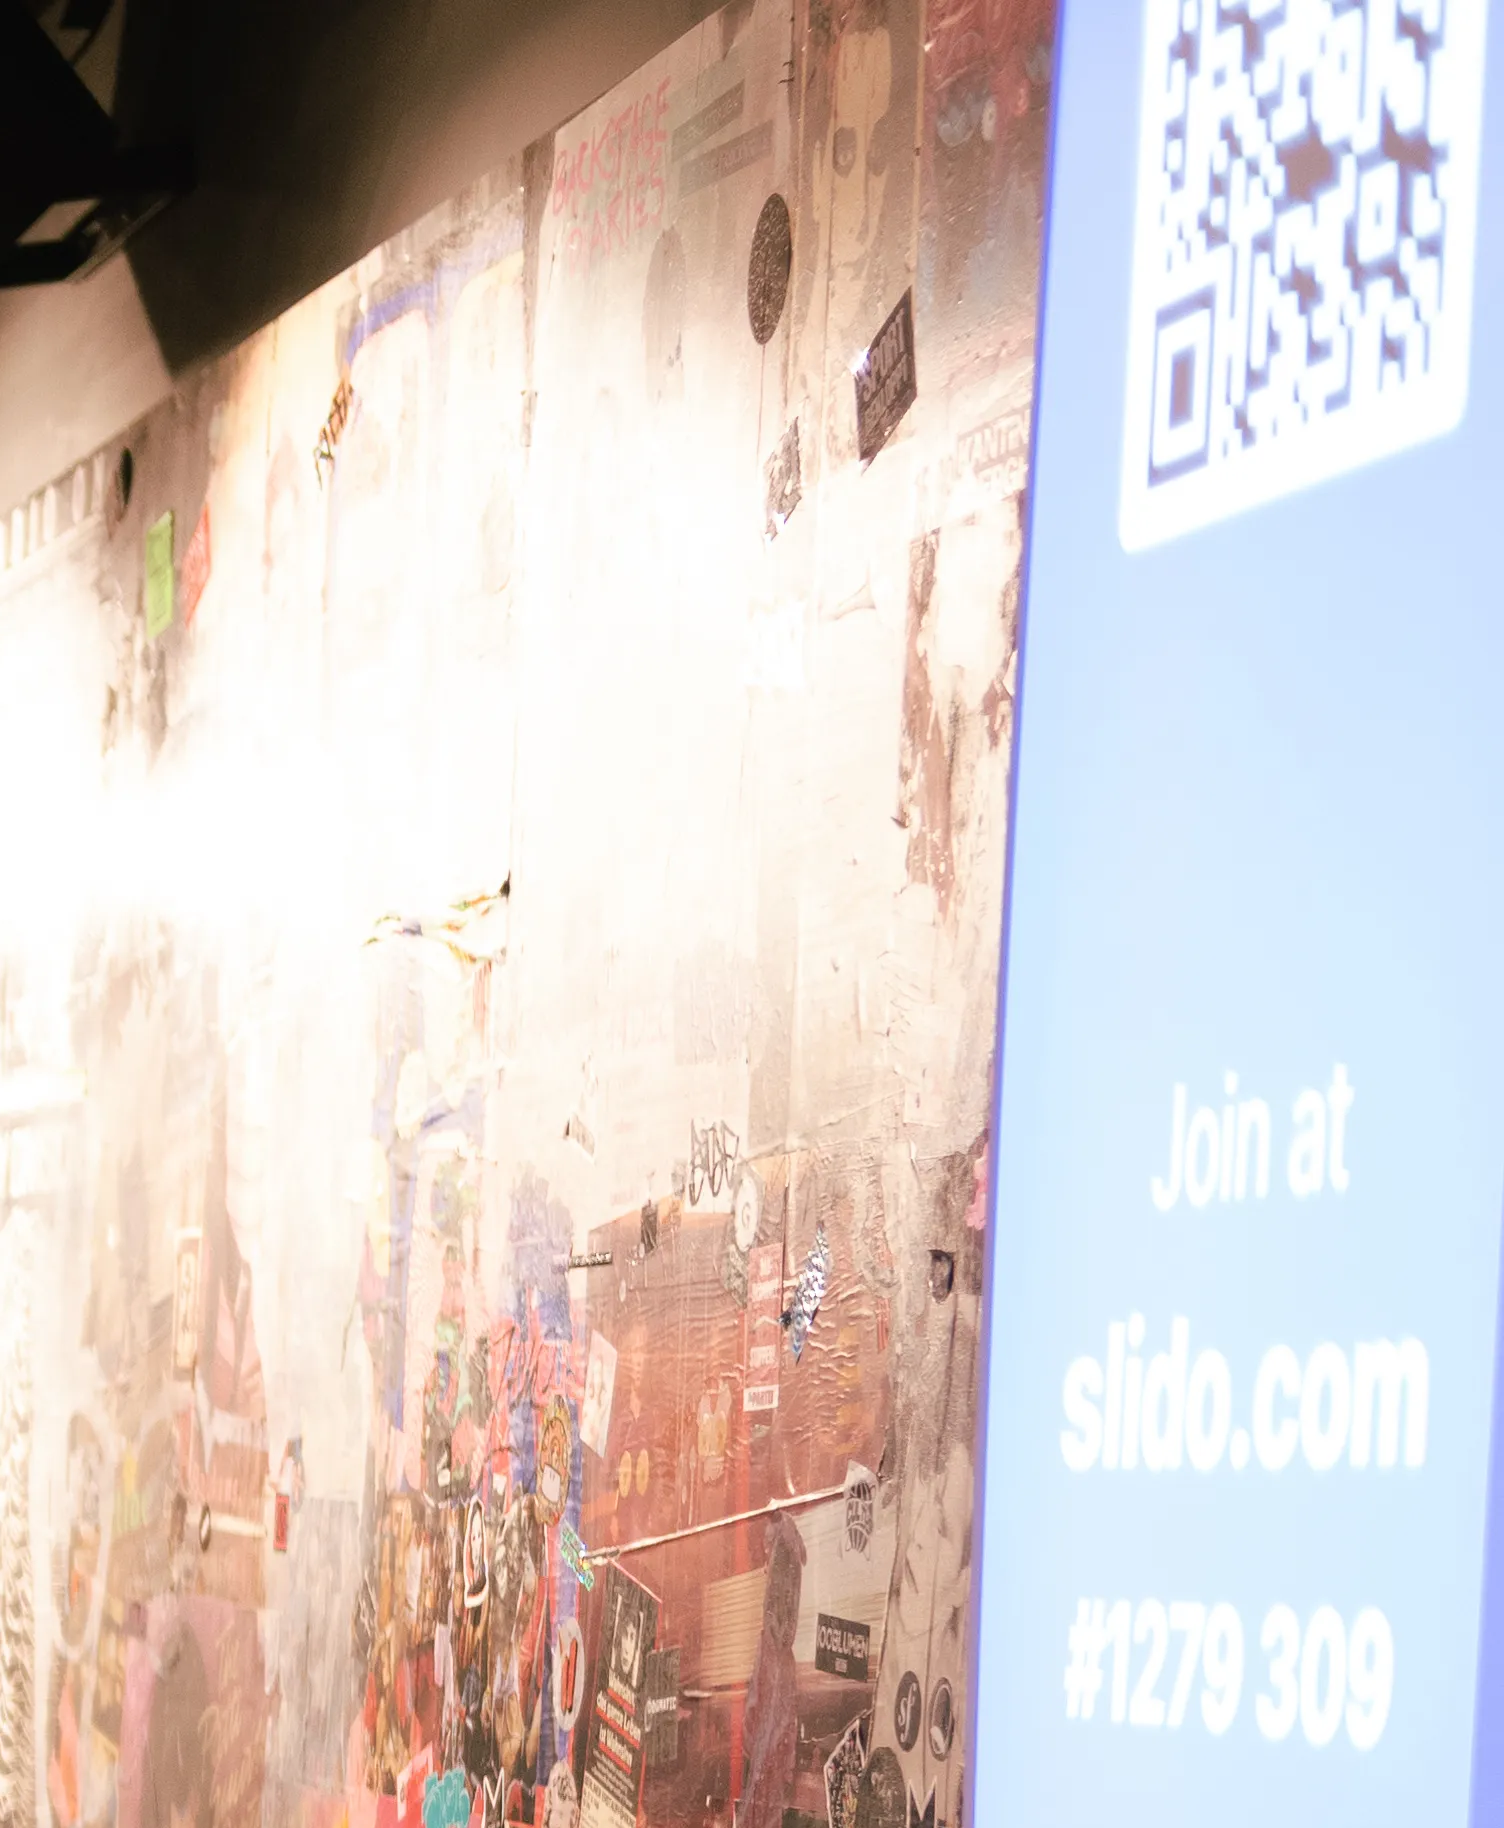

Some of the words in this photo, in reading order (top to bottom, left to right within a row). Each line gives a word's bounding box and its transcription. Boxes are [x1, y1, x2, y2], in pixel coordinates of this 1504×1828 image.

[1151, 1072, 1271, 1211] Join
[1288, 1062, 1354, 1197] at
[1060, 1310, 1429, 1472] slido.com
[1064, 1598, 1244, 1736] #1279
[1255, 1603, 1395, 1752] 309
